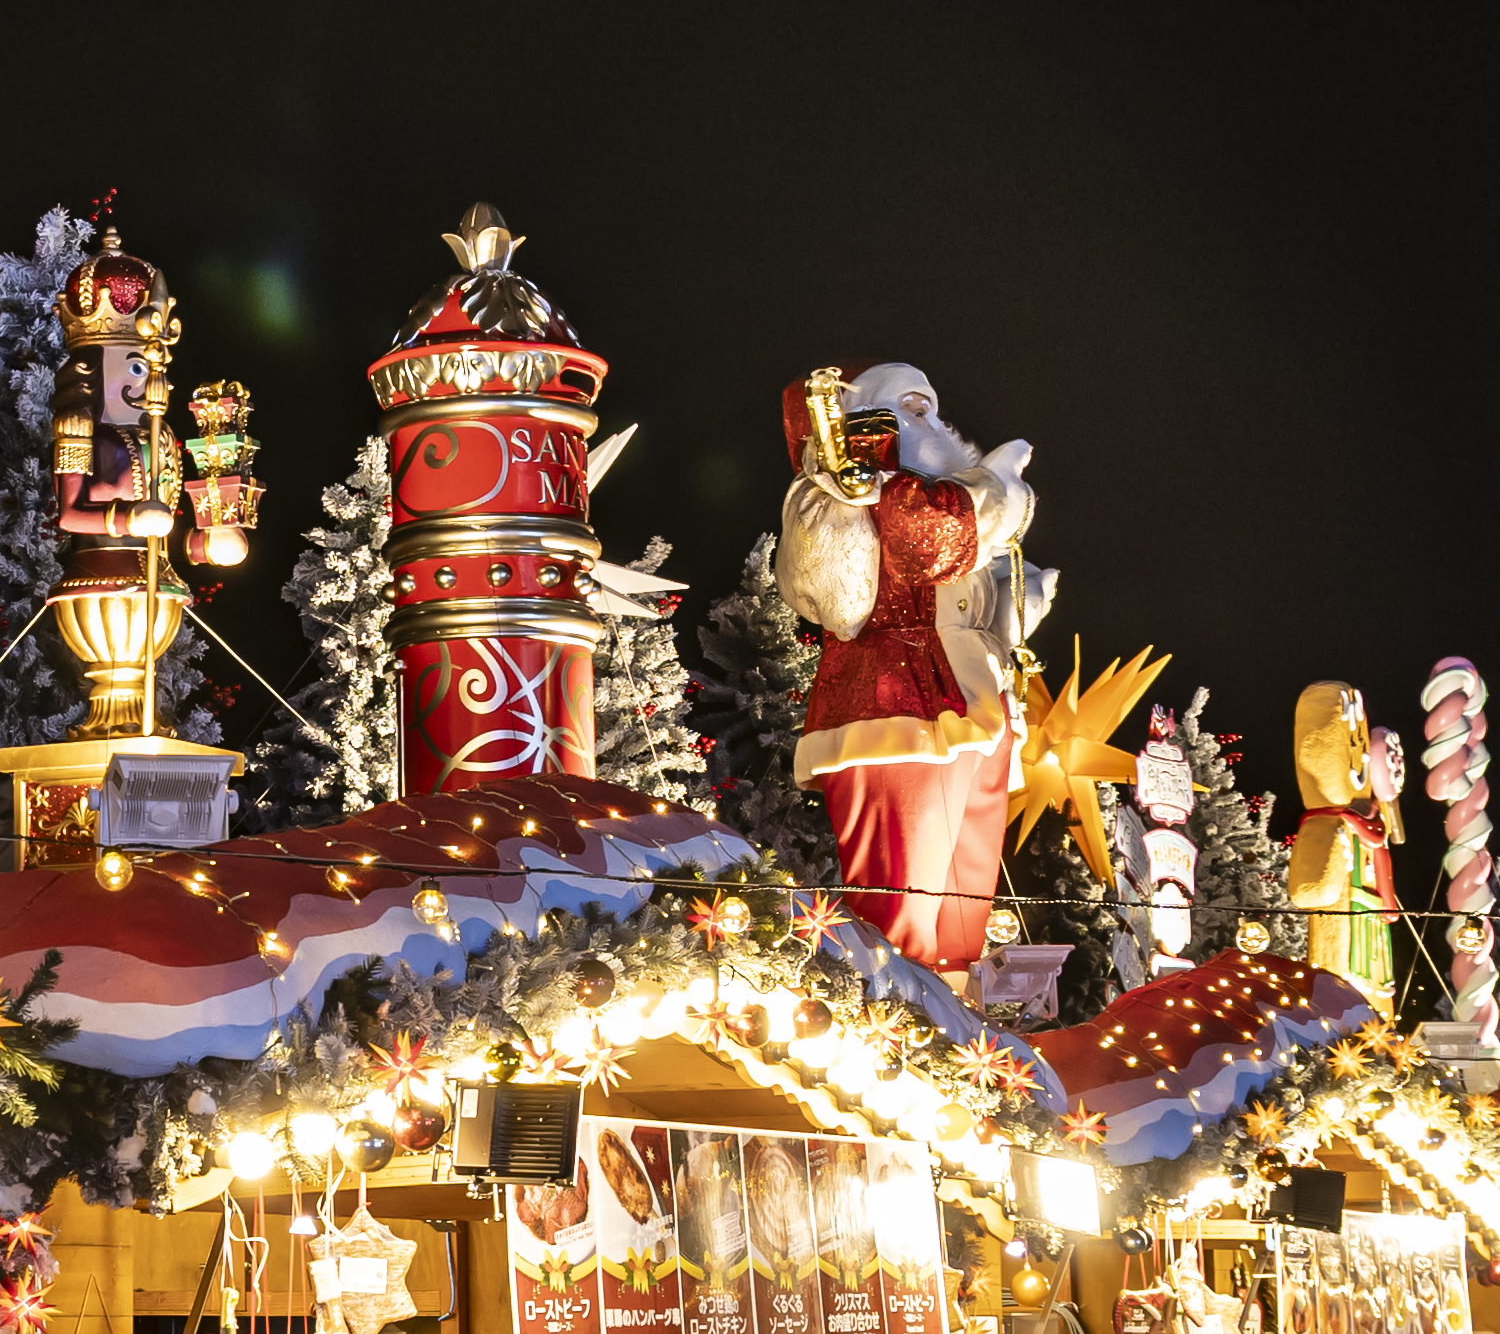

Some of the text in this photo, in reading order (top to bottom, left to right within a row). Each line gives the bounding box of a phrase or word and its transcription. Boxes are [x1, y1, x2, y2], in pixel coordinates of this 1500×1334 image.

[524, 1298, 591, 1320] ローストビーフ
[773, 1294, 803, 1314] ぐるぐる
[834, 1293, 871, 1311] クリスマス
[889, 1295, 934, 1313] ローストビーフ
[769, 1313, 809, 1334] ソーセージ
[828, 1313, 880, 1333] お肉盛り合わせ
